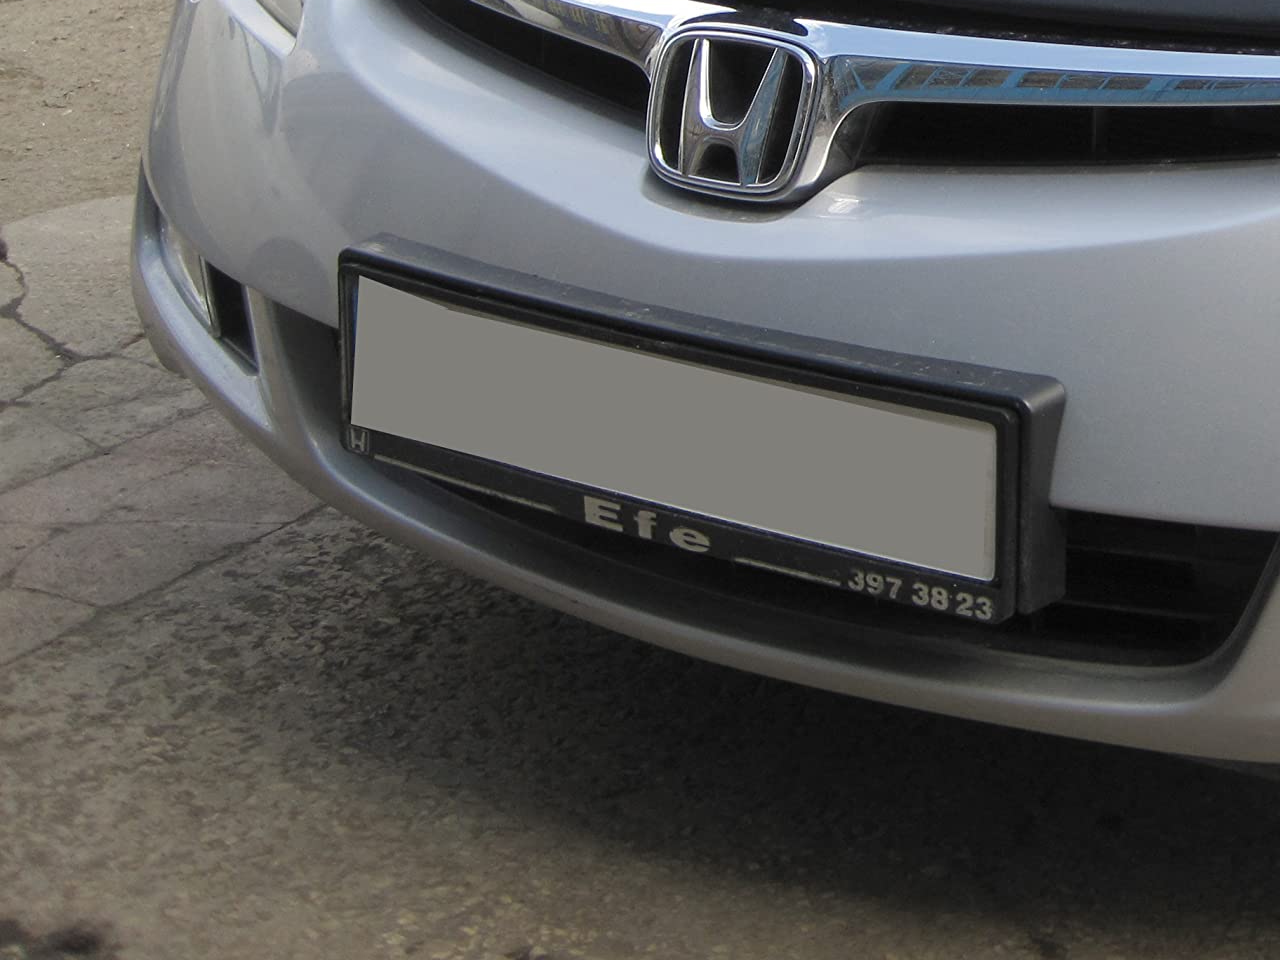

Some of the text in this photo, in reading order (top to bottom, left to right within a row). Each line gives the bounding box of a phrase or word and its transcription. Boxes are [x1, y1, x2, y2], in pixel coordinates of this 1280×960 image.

[583, 495, 711, 553] Efe
[848, 570, 993, 620] 397 38 23
